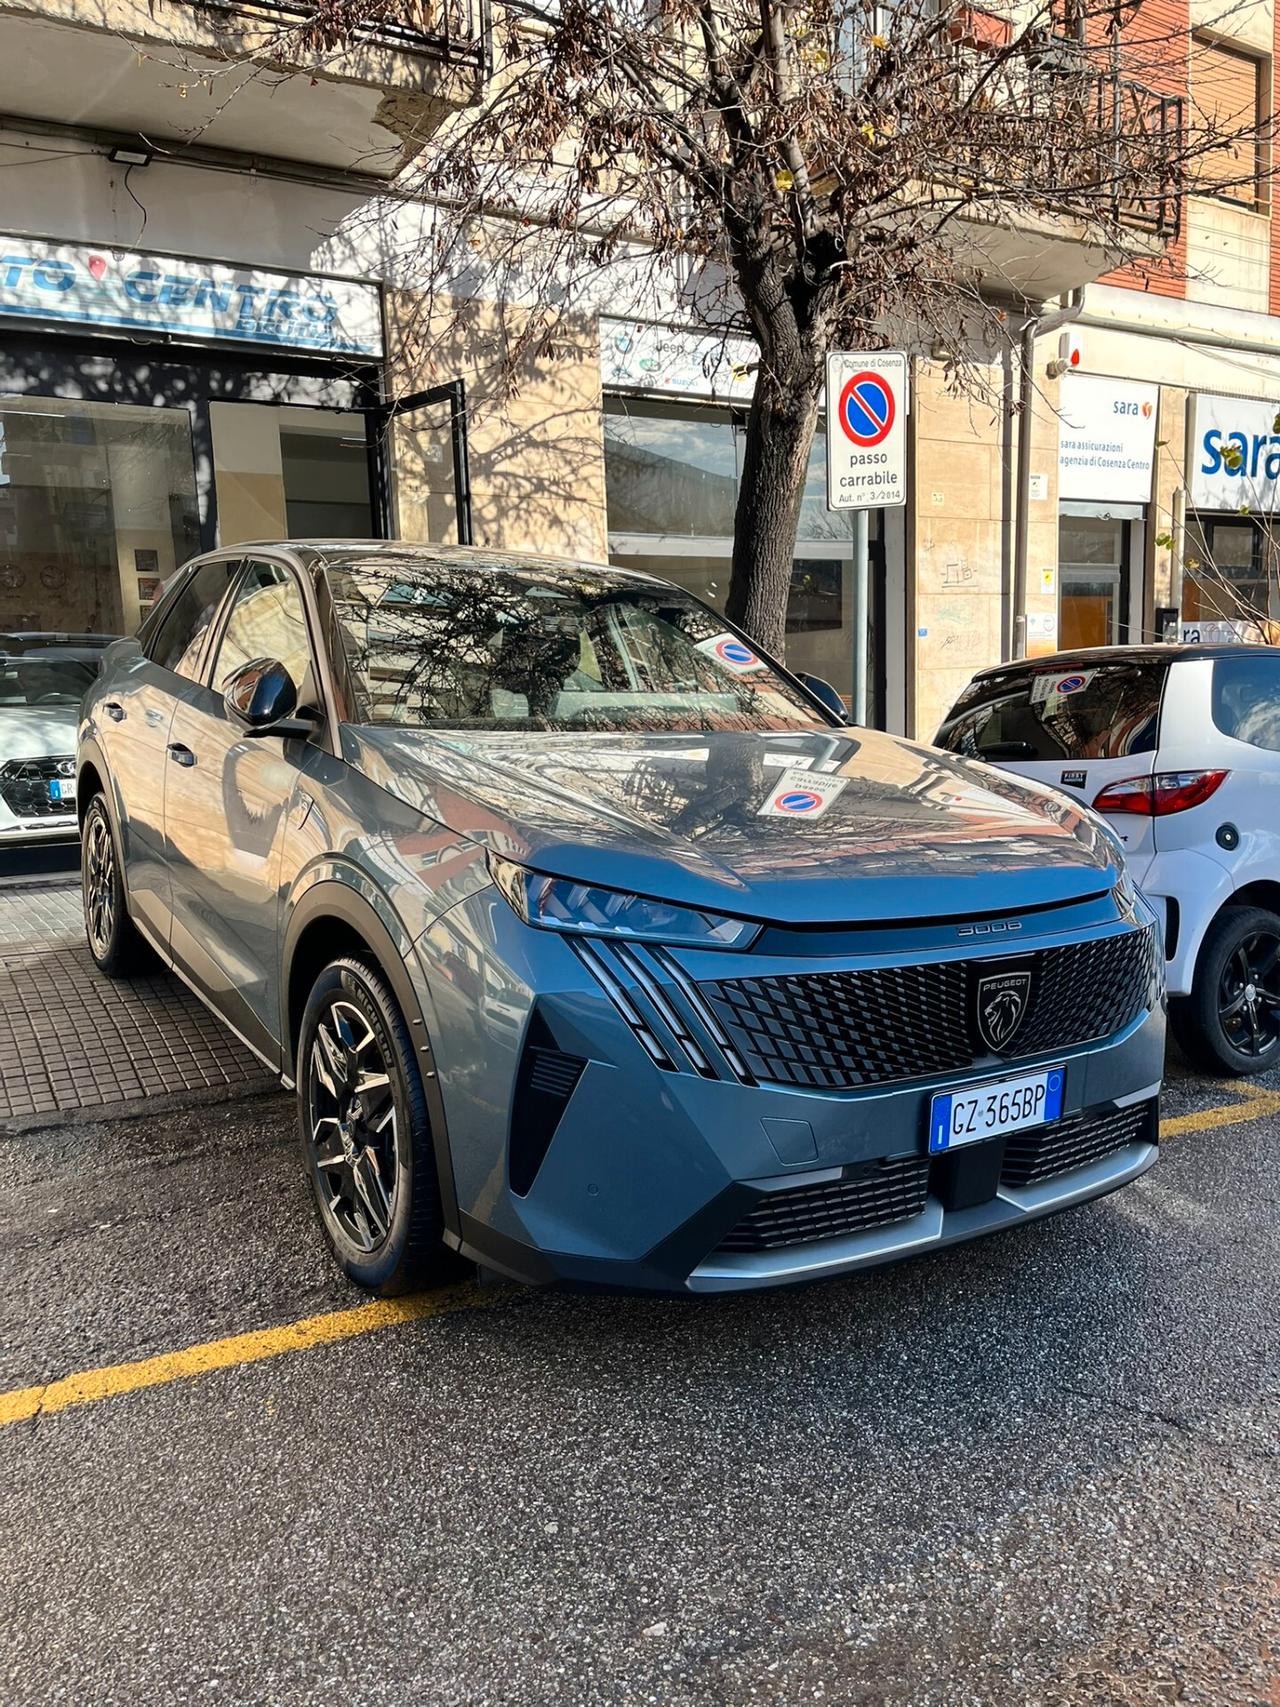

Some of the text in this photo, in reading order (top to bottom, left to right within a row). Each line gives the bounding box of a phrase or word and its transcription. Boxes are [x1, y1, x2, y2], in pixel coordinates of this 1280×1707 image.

[0, 255, 337, 323] TO CENTRO
[656, 340, 685, 356] Jeep
[844, 358, 902, 368] Comune di Cosenza
[1113, 400, 1139, 416] sara
[1060, 440, 1123, 452] sara assicurazioni
[850, 453, 888, 468] passo
[1201, 429, 1280, 480] sara
[1059, 456, 1150, 470] agenzia di Cosenza Centro
[840, 471, 898, 488] carrabile
[839, 493, 855, 503] Aut.
[870, 490, 900, 501] 3/2014
[958, 920, 1022, 937] 3008
[983, 978, 1027, 992] PEUGEOT
[356, 987, 393, 1065] MICHELIN
